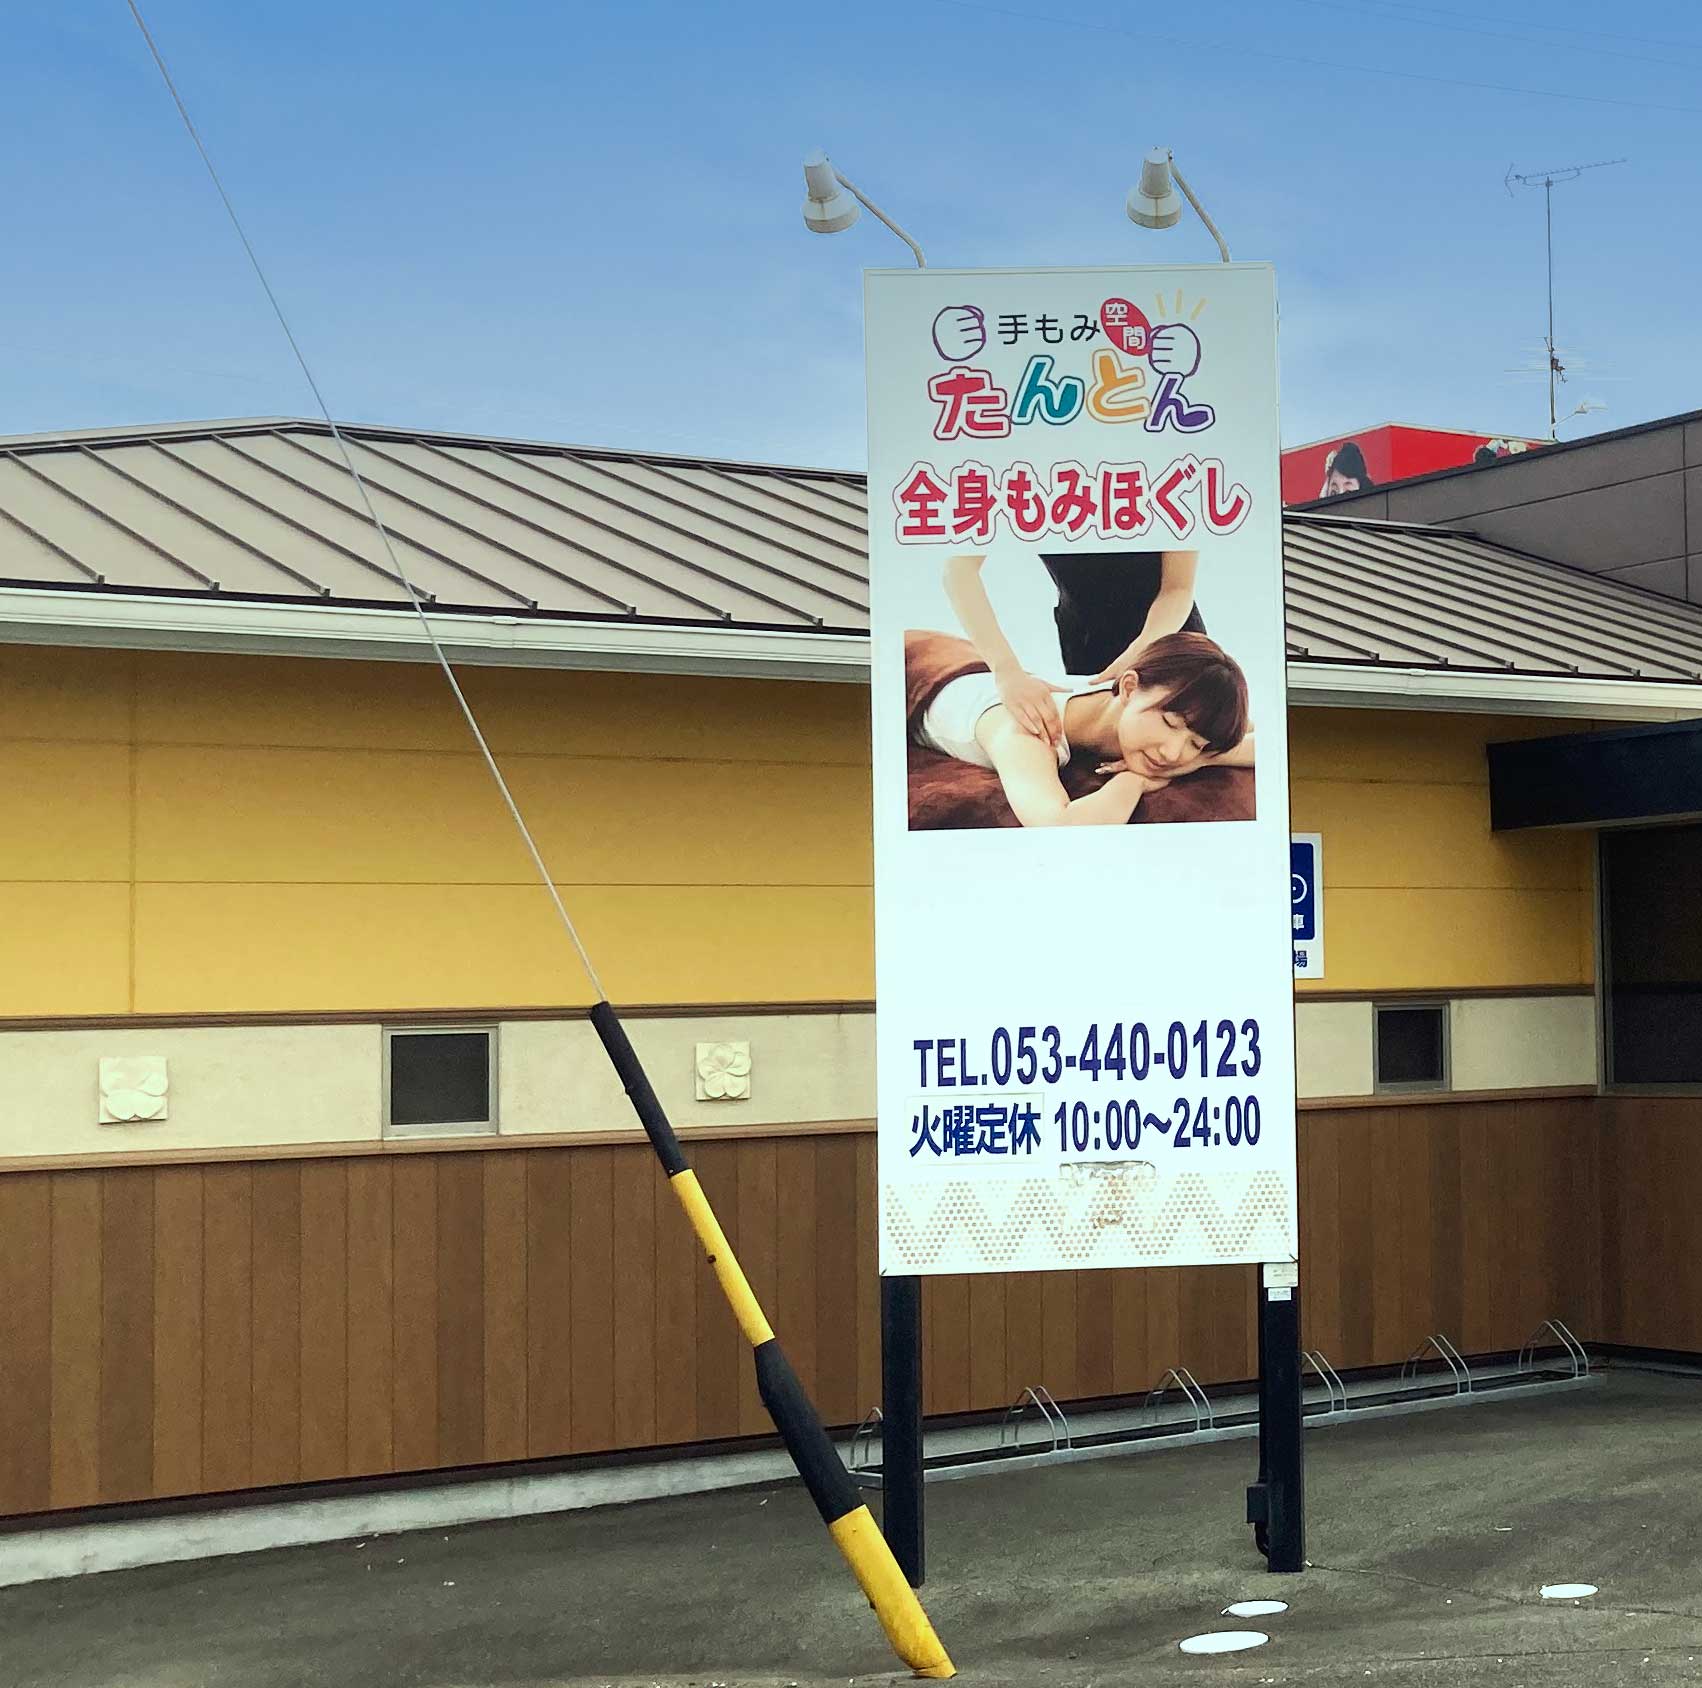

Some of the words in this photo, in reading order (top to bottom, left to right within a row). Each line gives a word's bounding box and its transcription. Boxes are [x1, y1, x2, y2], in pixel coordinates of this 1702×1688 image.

[997, 314, 1101, 346] 手もみ
[1104, 302, 1148, 350] 空間
[928, 349, 1216, 440] たんとん
[897, 459, 1247, 540] 全身もみほぐし
[912, 1018, 1262, 1088] TEL.053-440-0123
[908, 1102, 1042, 1158] 火曜定休
